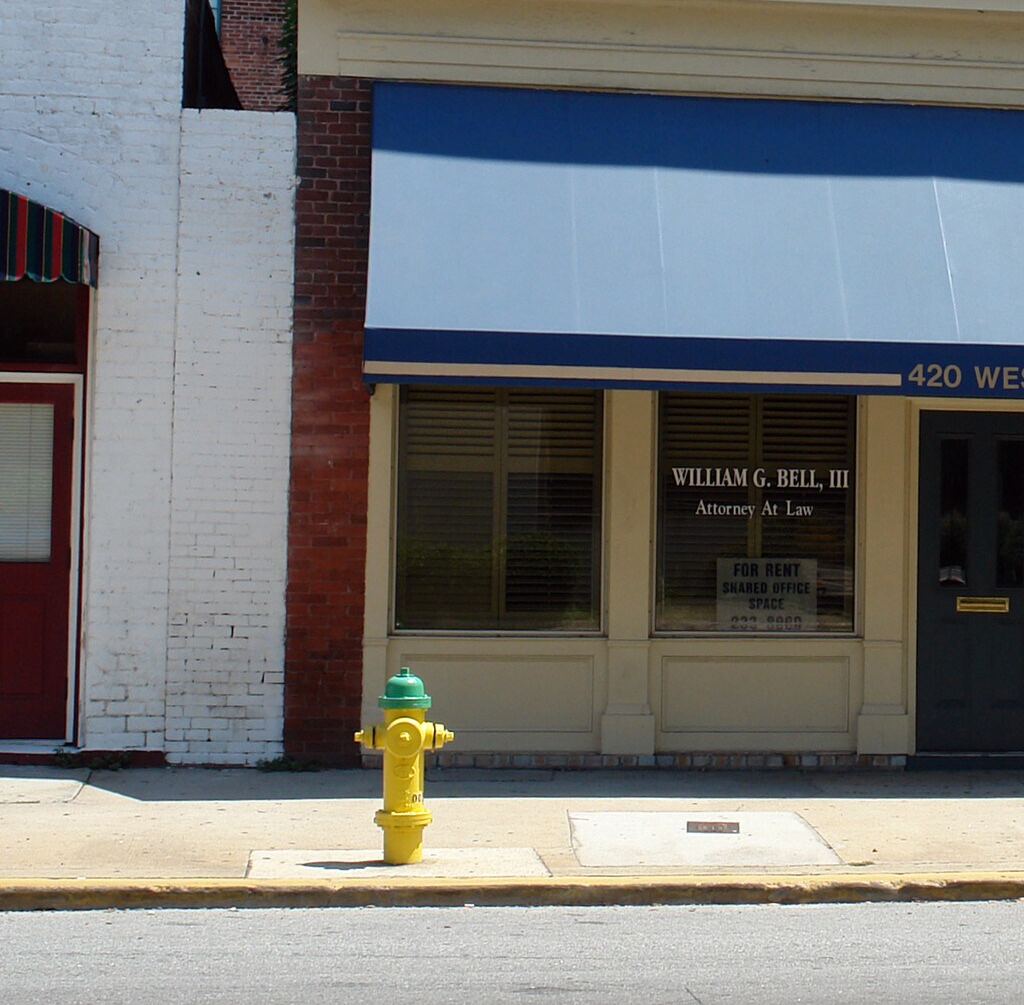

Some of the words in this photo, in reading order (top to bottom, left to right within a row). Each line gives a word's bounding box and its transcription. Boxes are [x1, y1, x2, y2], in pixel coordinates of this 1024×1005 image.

[908, 364, 962, 388] 420
[672, 467, 748, 487] WILLIAM
[752, 468, 771, 488] G.
[777, 468, 823, 491] BELL,
[829, 469, 850, 489] III
[695, 499, 755, 519] Attorney
[761, 500, 778, 516] At
[786, 500, 814, 516] Law
[733, 563, 759, 577] FOR
[765, 563, 801, 577] RENT
[722, 582, 768, 595] SHARED
[773, 582, 811, 595] OFFICE
[748, 598, 784, 610] SPACE
